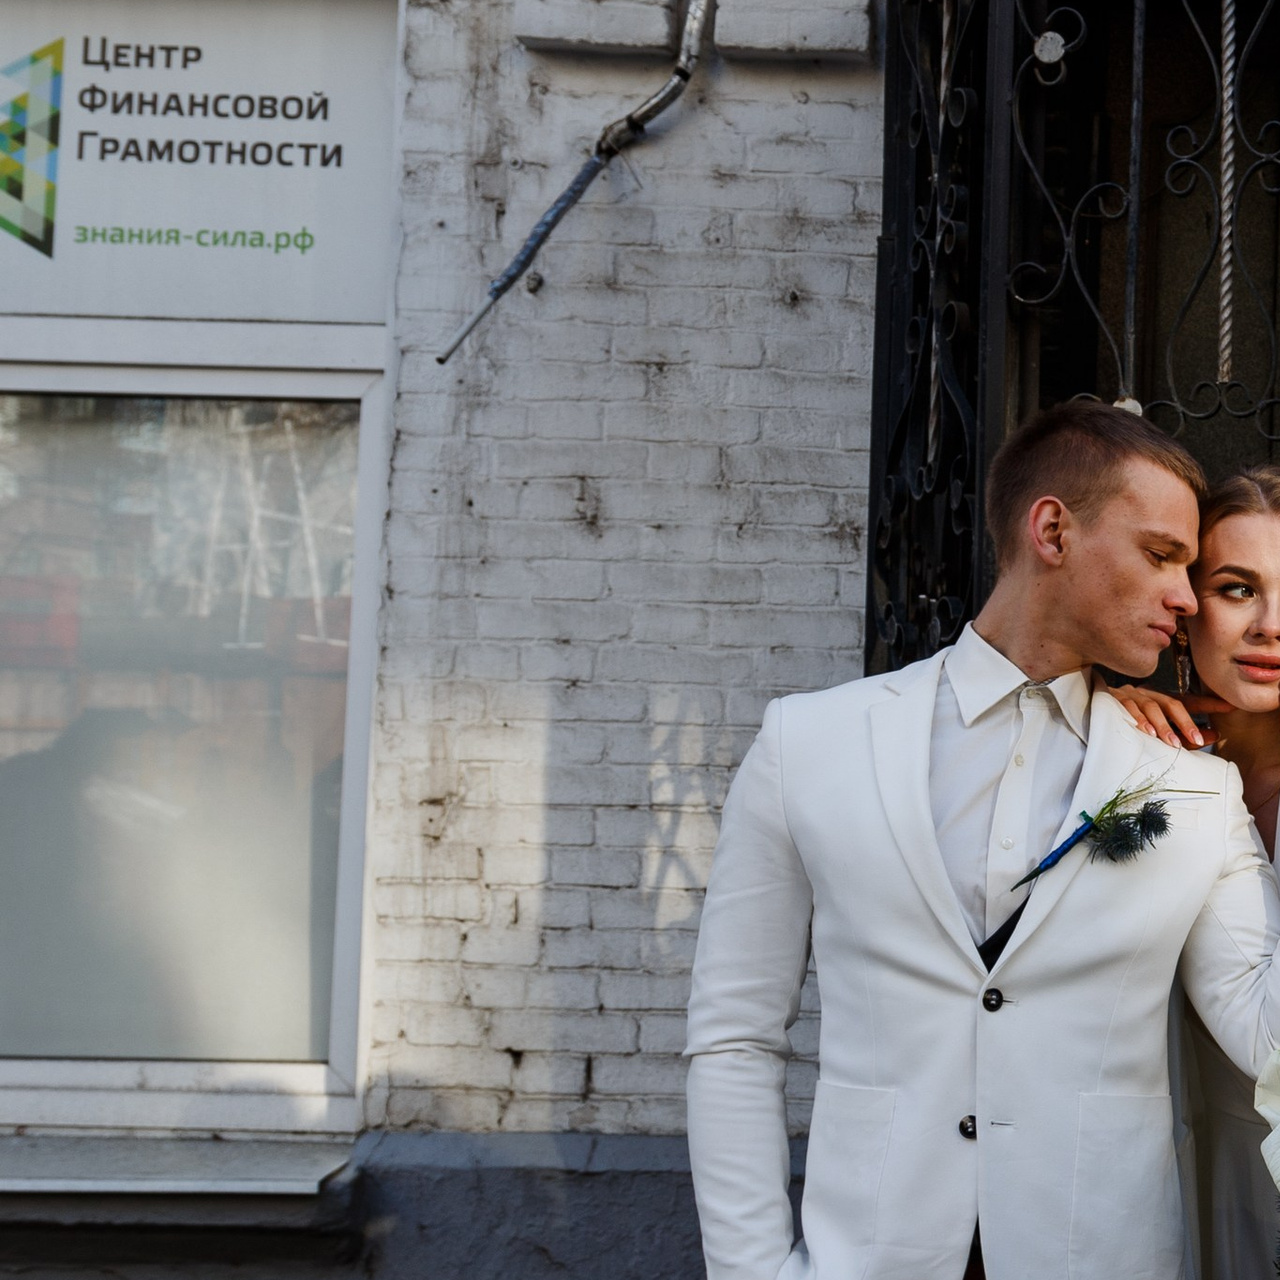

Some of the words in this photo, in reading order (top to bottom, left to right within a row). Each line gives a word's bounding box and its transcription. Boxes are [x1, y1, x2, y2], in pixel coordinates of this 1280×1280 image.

[81, 36, 203, 71] ЦЕНТР
[78, 83, 329, 121] ФИНАНСОВОЙ
[76, 131, 343, 168] ГРАМОТНОСТИ
[73, 225, 315, 254] знания-сила.рф
